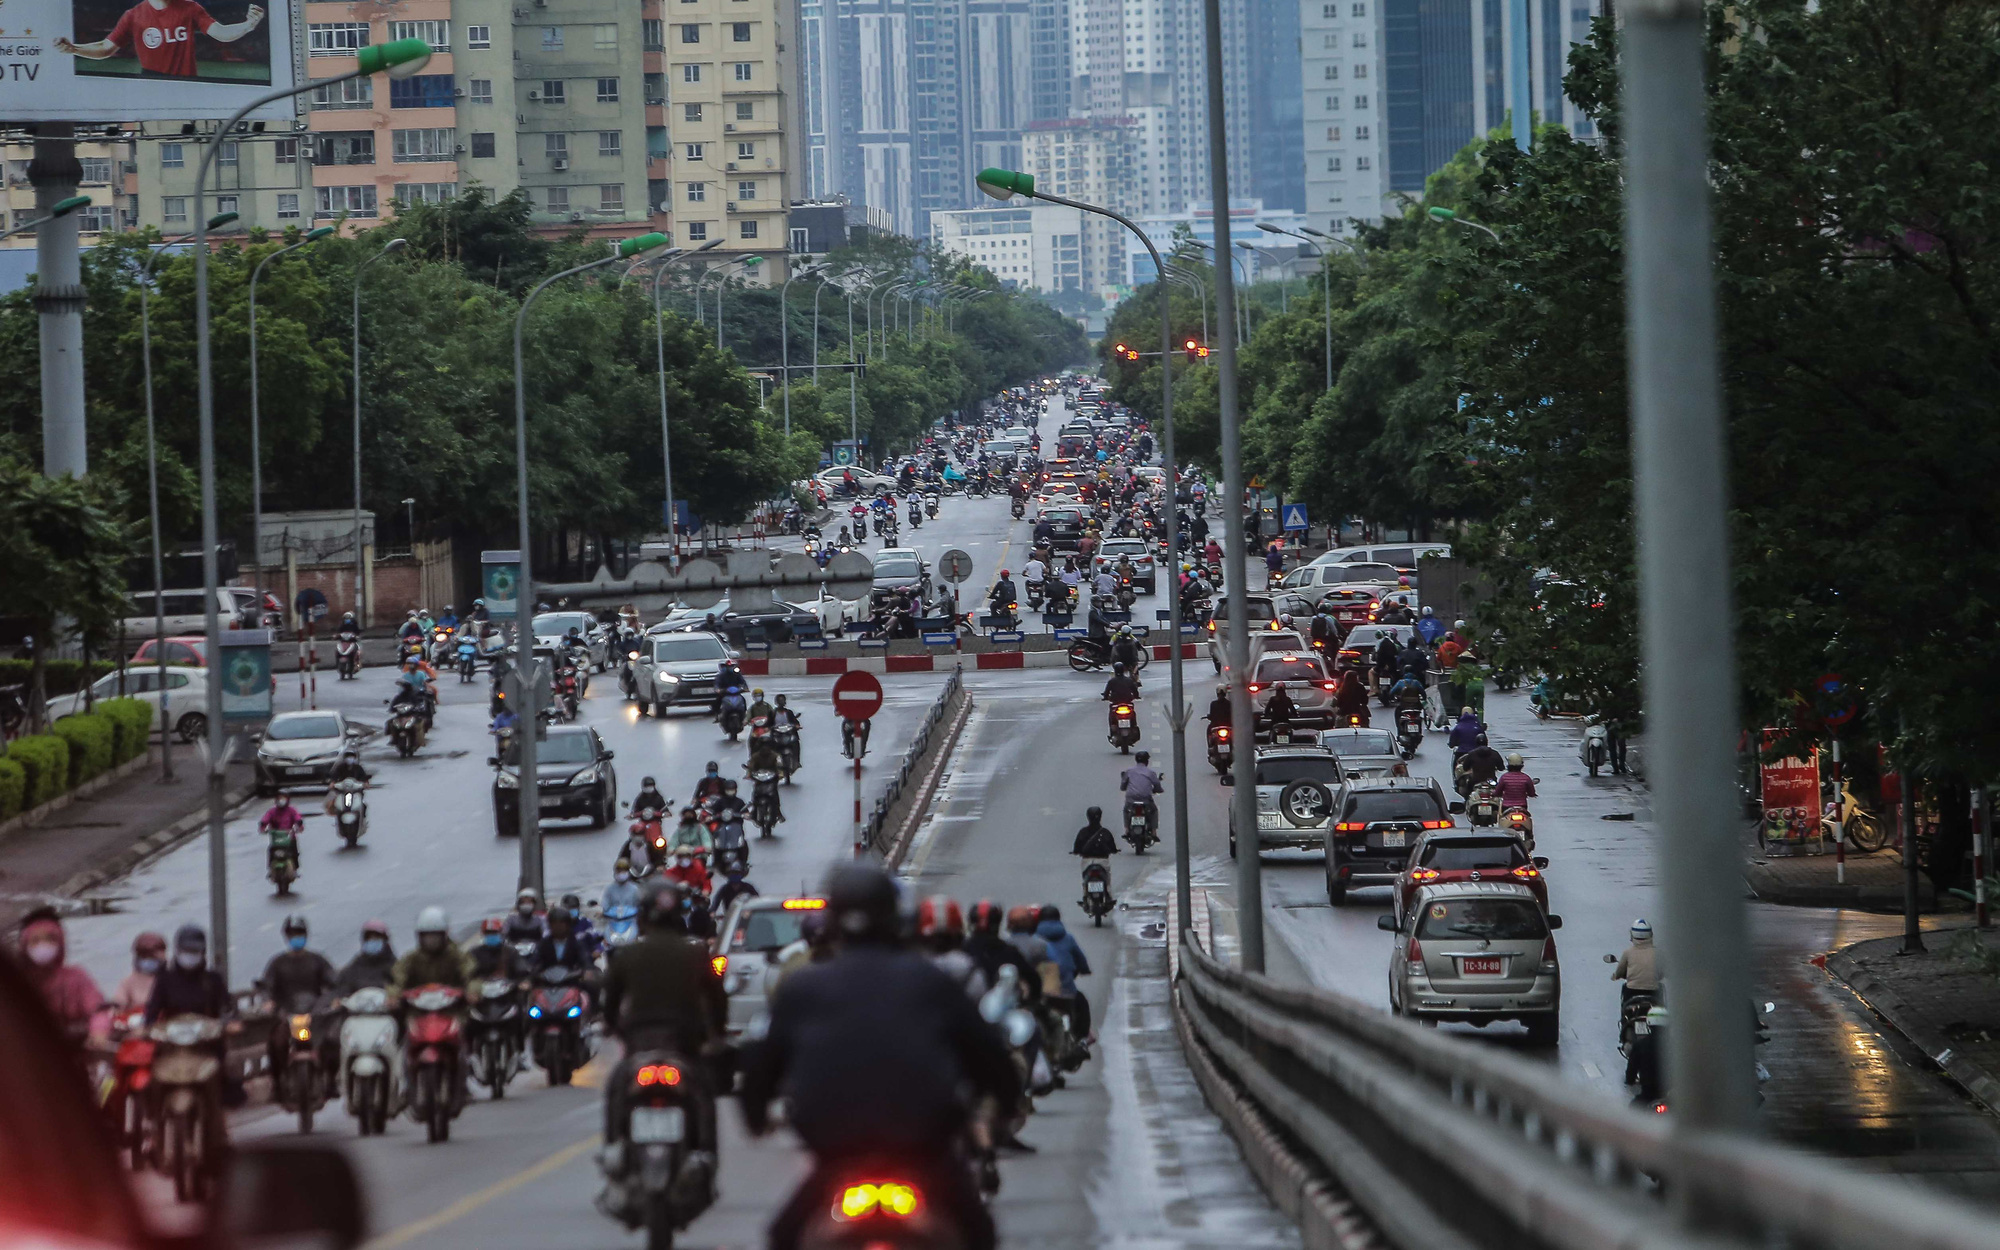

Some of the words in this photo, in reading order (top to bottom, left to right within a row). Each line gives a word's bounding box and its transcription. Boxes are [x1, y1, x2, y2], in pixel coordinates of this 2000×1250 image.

[164, 26, 188, 43] LG
[16, 45, 42, 56] Giới
[8, 63, 39, 81] TV
[1196, 346, 1209, 357] 30
